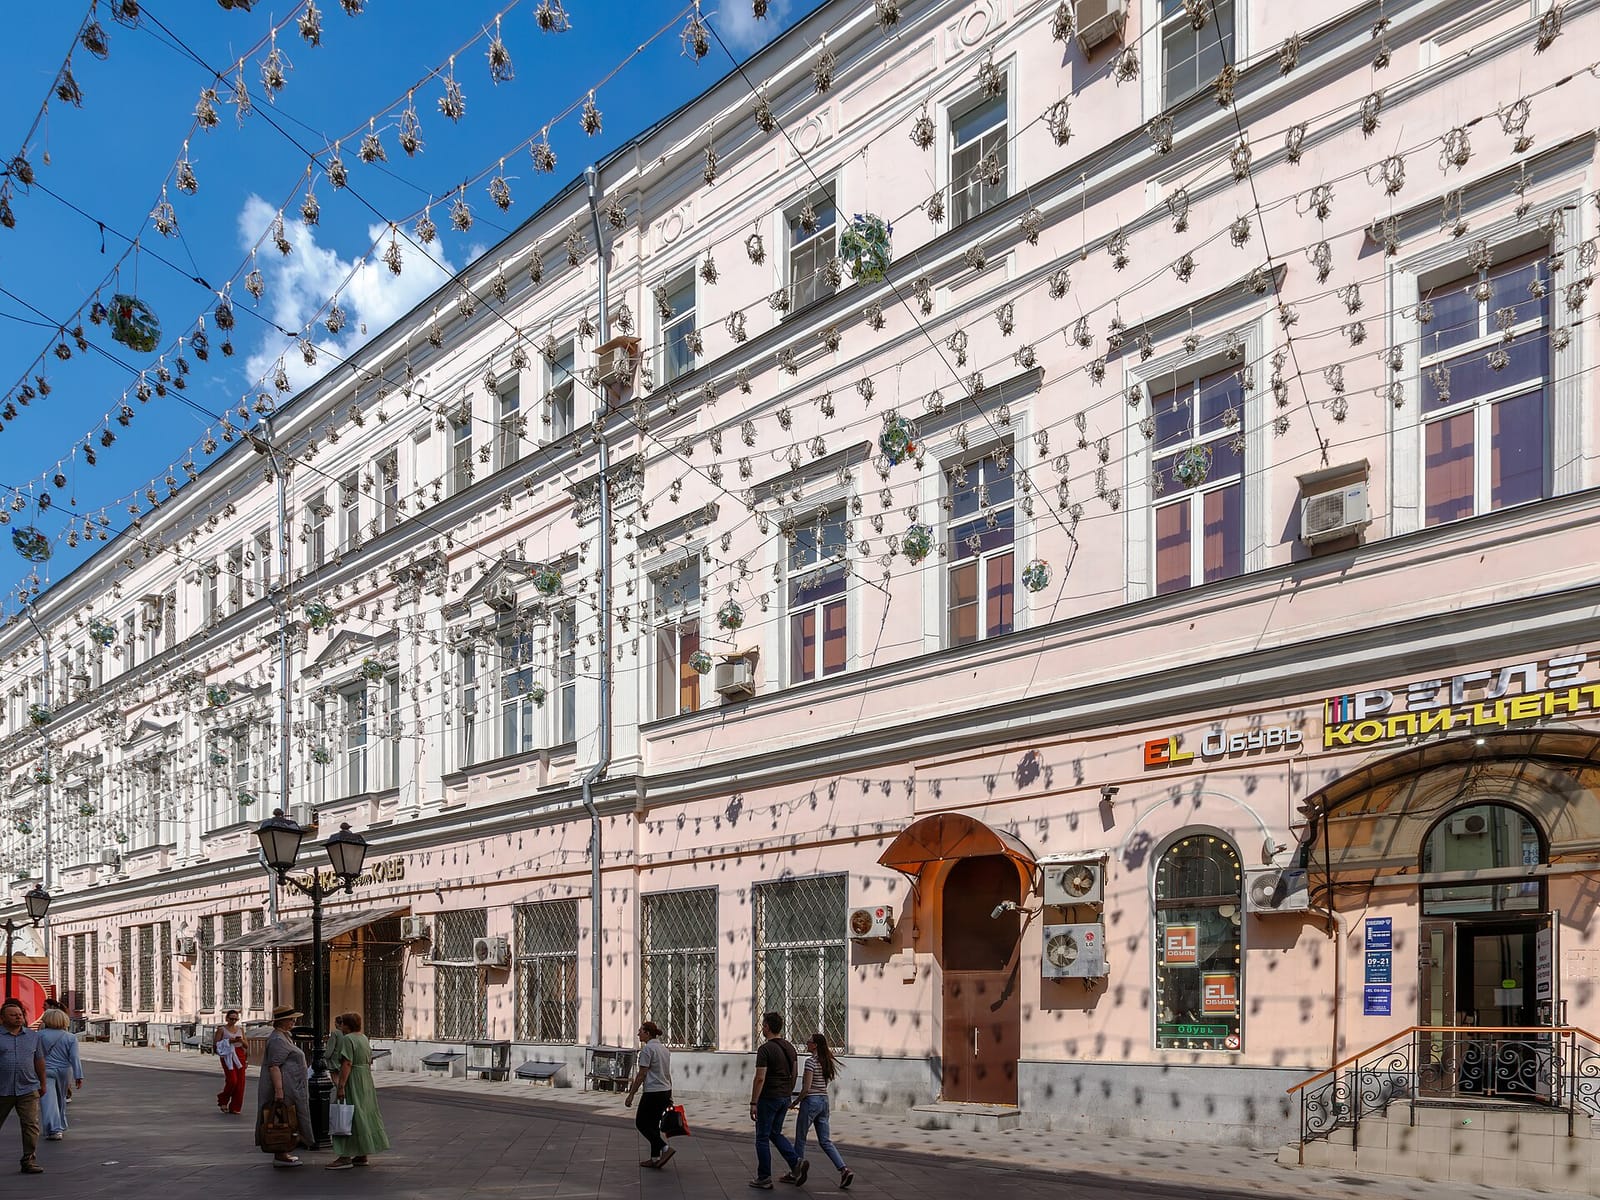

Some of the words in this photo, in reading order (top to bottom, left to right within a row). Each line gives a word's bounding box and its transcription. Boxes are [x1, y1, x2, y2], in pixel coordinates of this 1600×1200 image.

[1325, 685, 1600, 747] КОПИ-ЦЕНТ
[1145, 735, 1194, 765] EL
[1167, 936, 1195, 950] EL
[1205, 985, 1234, 999] EL
